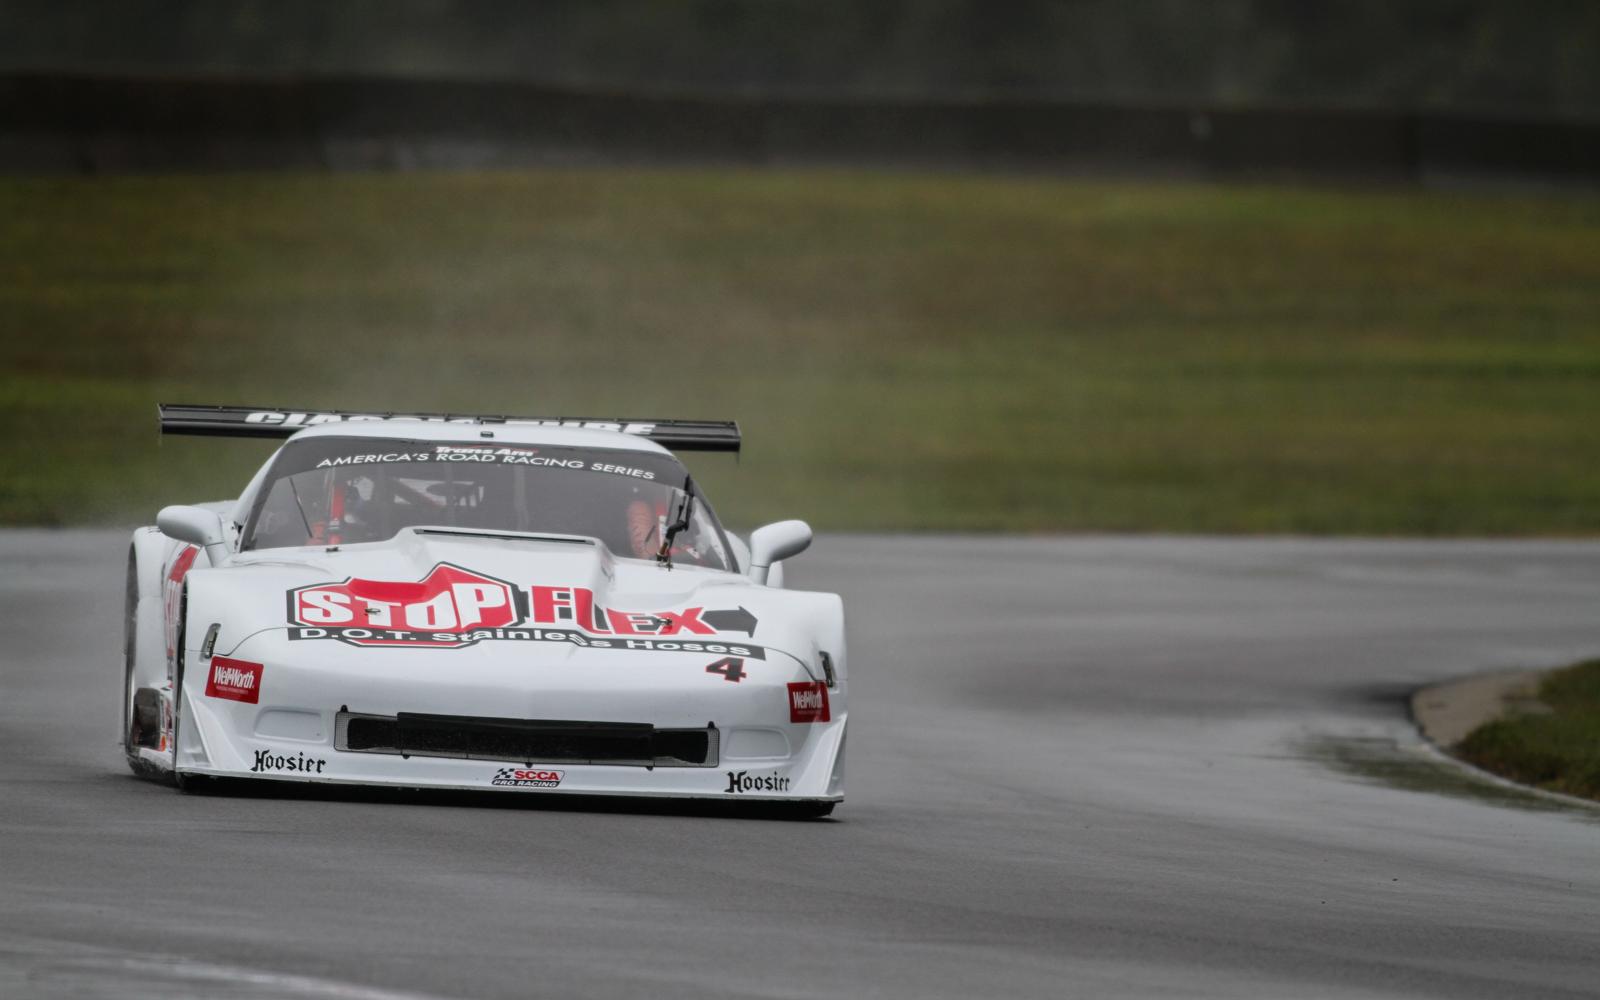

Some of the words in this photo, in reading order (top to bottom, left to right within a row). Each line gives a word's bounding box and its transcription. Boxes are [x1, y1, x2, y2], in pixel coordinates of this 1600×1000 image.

[436, 446, 494, 455] Trans
[494, 448, 534, 457] Am
[316, 453, 430, 468] AMERICA'S
[436, 453, 496, 462] ROAD
[502, 455, 584, 469] RACING
[591, 462, 655, 480] SERIES
[301, 582, 507, 630] STOP
[531, 585, 718, 636] FLEX
[300, 628, 417, 641] D.O.T.
[432, 628, 612, 648] Stainless
[626, 640, 751, 657] Hoses
[705, 656, 747, 683] 4
[250, 749, 326, 774] Hoosier
[493, 779, 516, 787] PRO
[516, 780, 558, 788] RACING
[514, 770, 560, 781] SCCA
[724, 770, 790, 794] Hoosier
